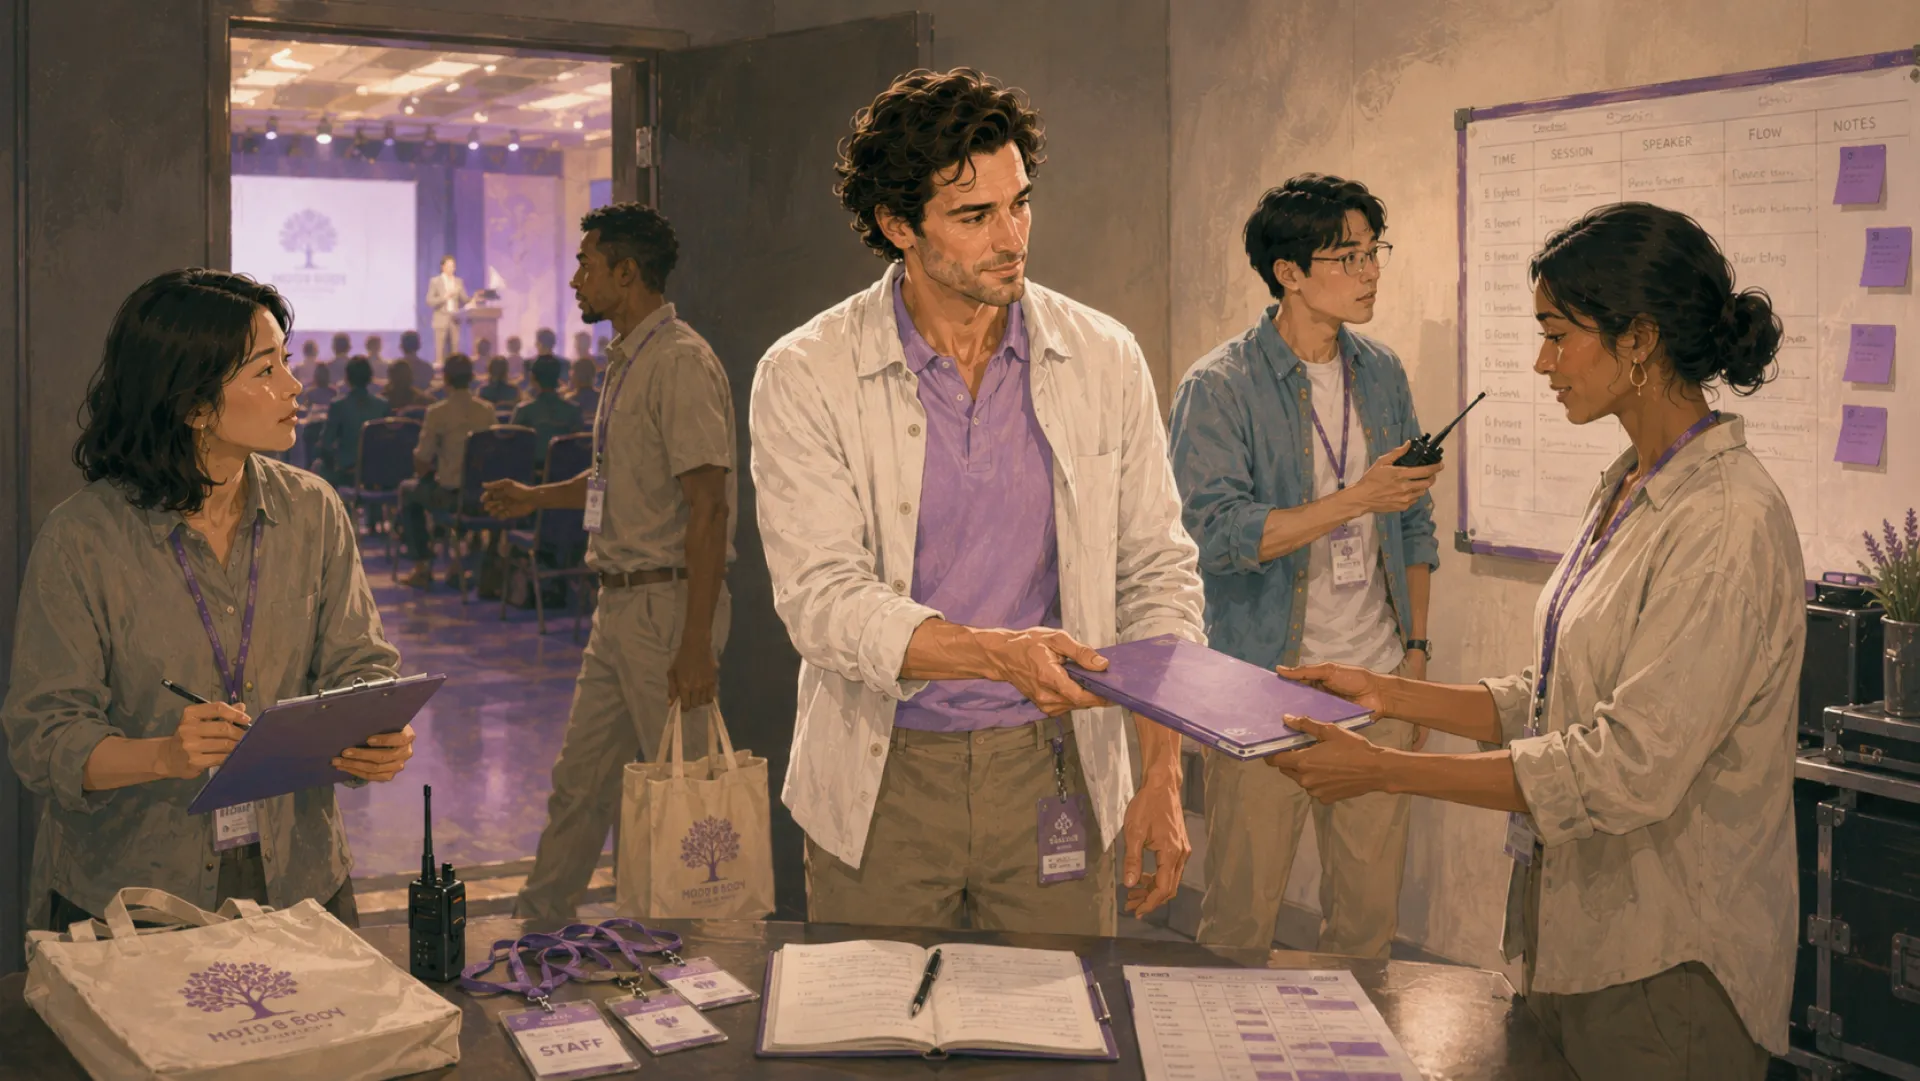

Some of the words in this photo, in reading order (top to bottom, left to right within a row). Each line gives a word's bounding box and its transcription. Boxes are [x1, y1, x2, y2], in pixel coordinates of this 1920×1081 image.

[1491, 153, 1517, 166] TIME
[1550, 146, 1594, 161] SESSION
[1642, 135, 1693, 151] SPEAKER
[1748, 126, 1783, 141] FLOW
[1832, 116, 1877, 133] NOTES
[540, 1038, 604, 1057] STAFF
